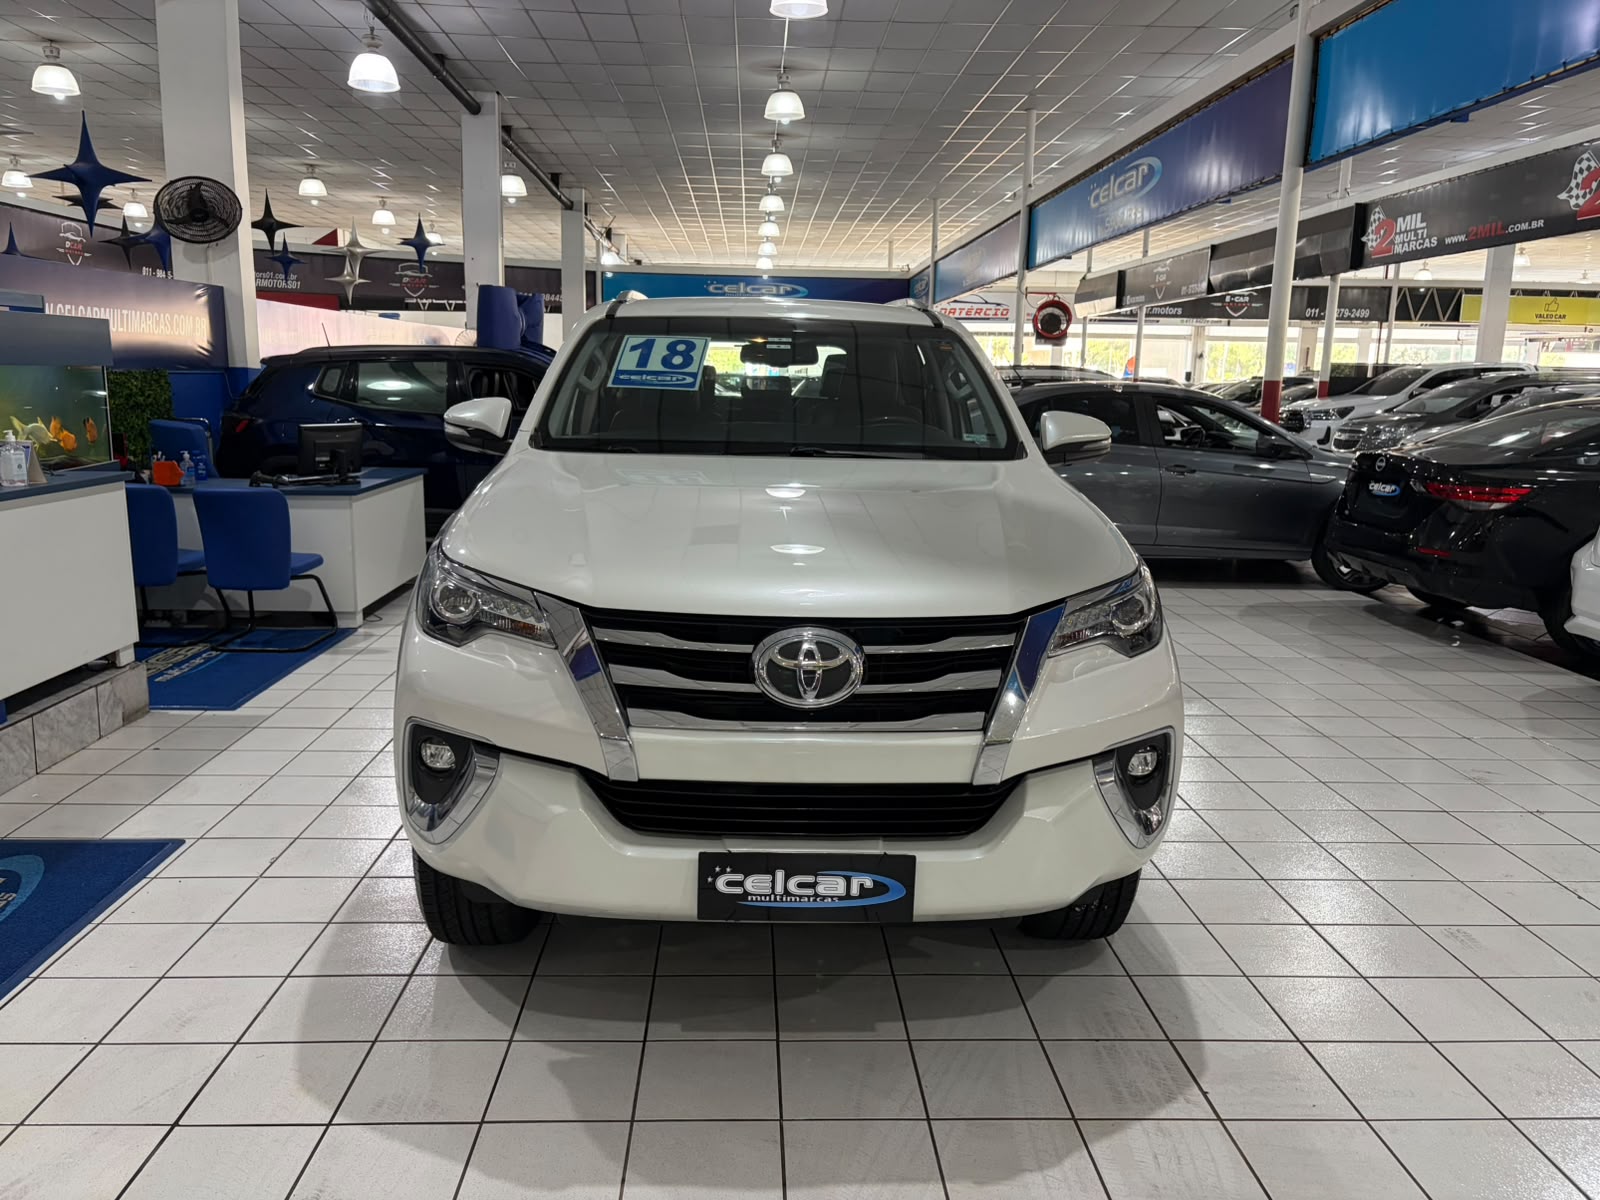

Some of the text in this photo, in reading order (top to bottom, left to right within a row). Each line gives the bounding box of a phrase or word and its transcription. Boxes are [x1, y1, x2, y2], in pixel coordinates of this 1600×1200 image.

[1090, 164, 1149, 209] celcar
[1396, 212, 1427, 233] MIL
[1371, 218, 1397, 259] 2
[1393, 237, 1438, 254] MARCAS
[1395, 228, 1428, 244] MULTI
[708, 282, 792, 295] celcar
[1305, 308, 1319, 317] 011
[629, 338, 697, 370] 18
[715, 869, 874, 897] celcar
[748, 894, 839, 903] multimarcas
